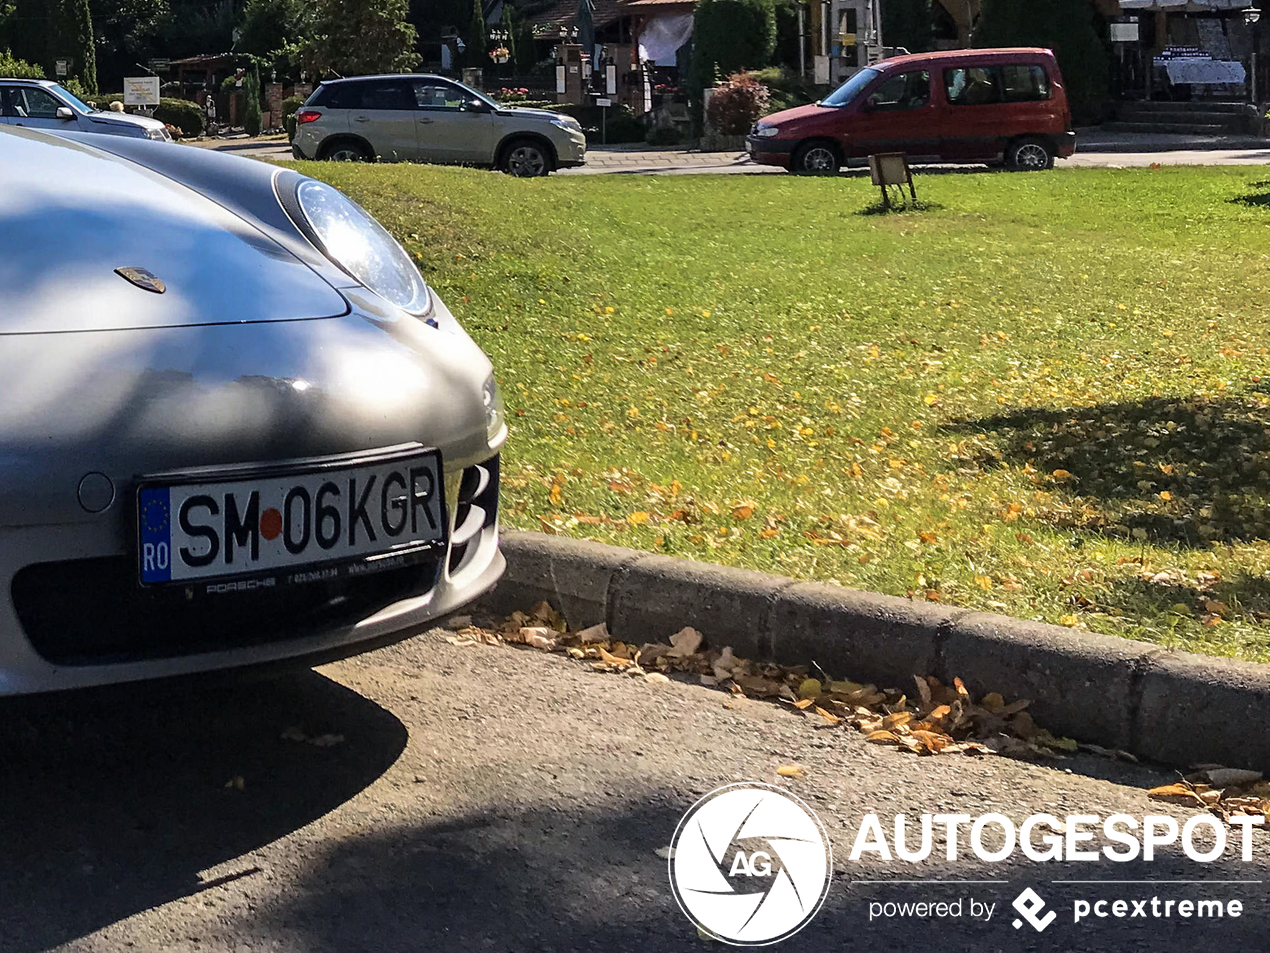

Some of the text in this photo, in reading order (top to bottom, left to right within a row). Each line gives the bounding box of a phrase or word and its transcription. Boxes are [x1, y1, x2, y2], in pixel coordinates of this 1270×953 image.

[178, 490, 260, 567] SM
[143, 541, 169, 572] RO
[206, 577, 276, 594] PORSCHE
